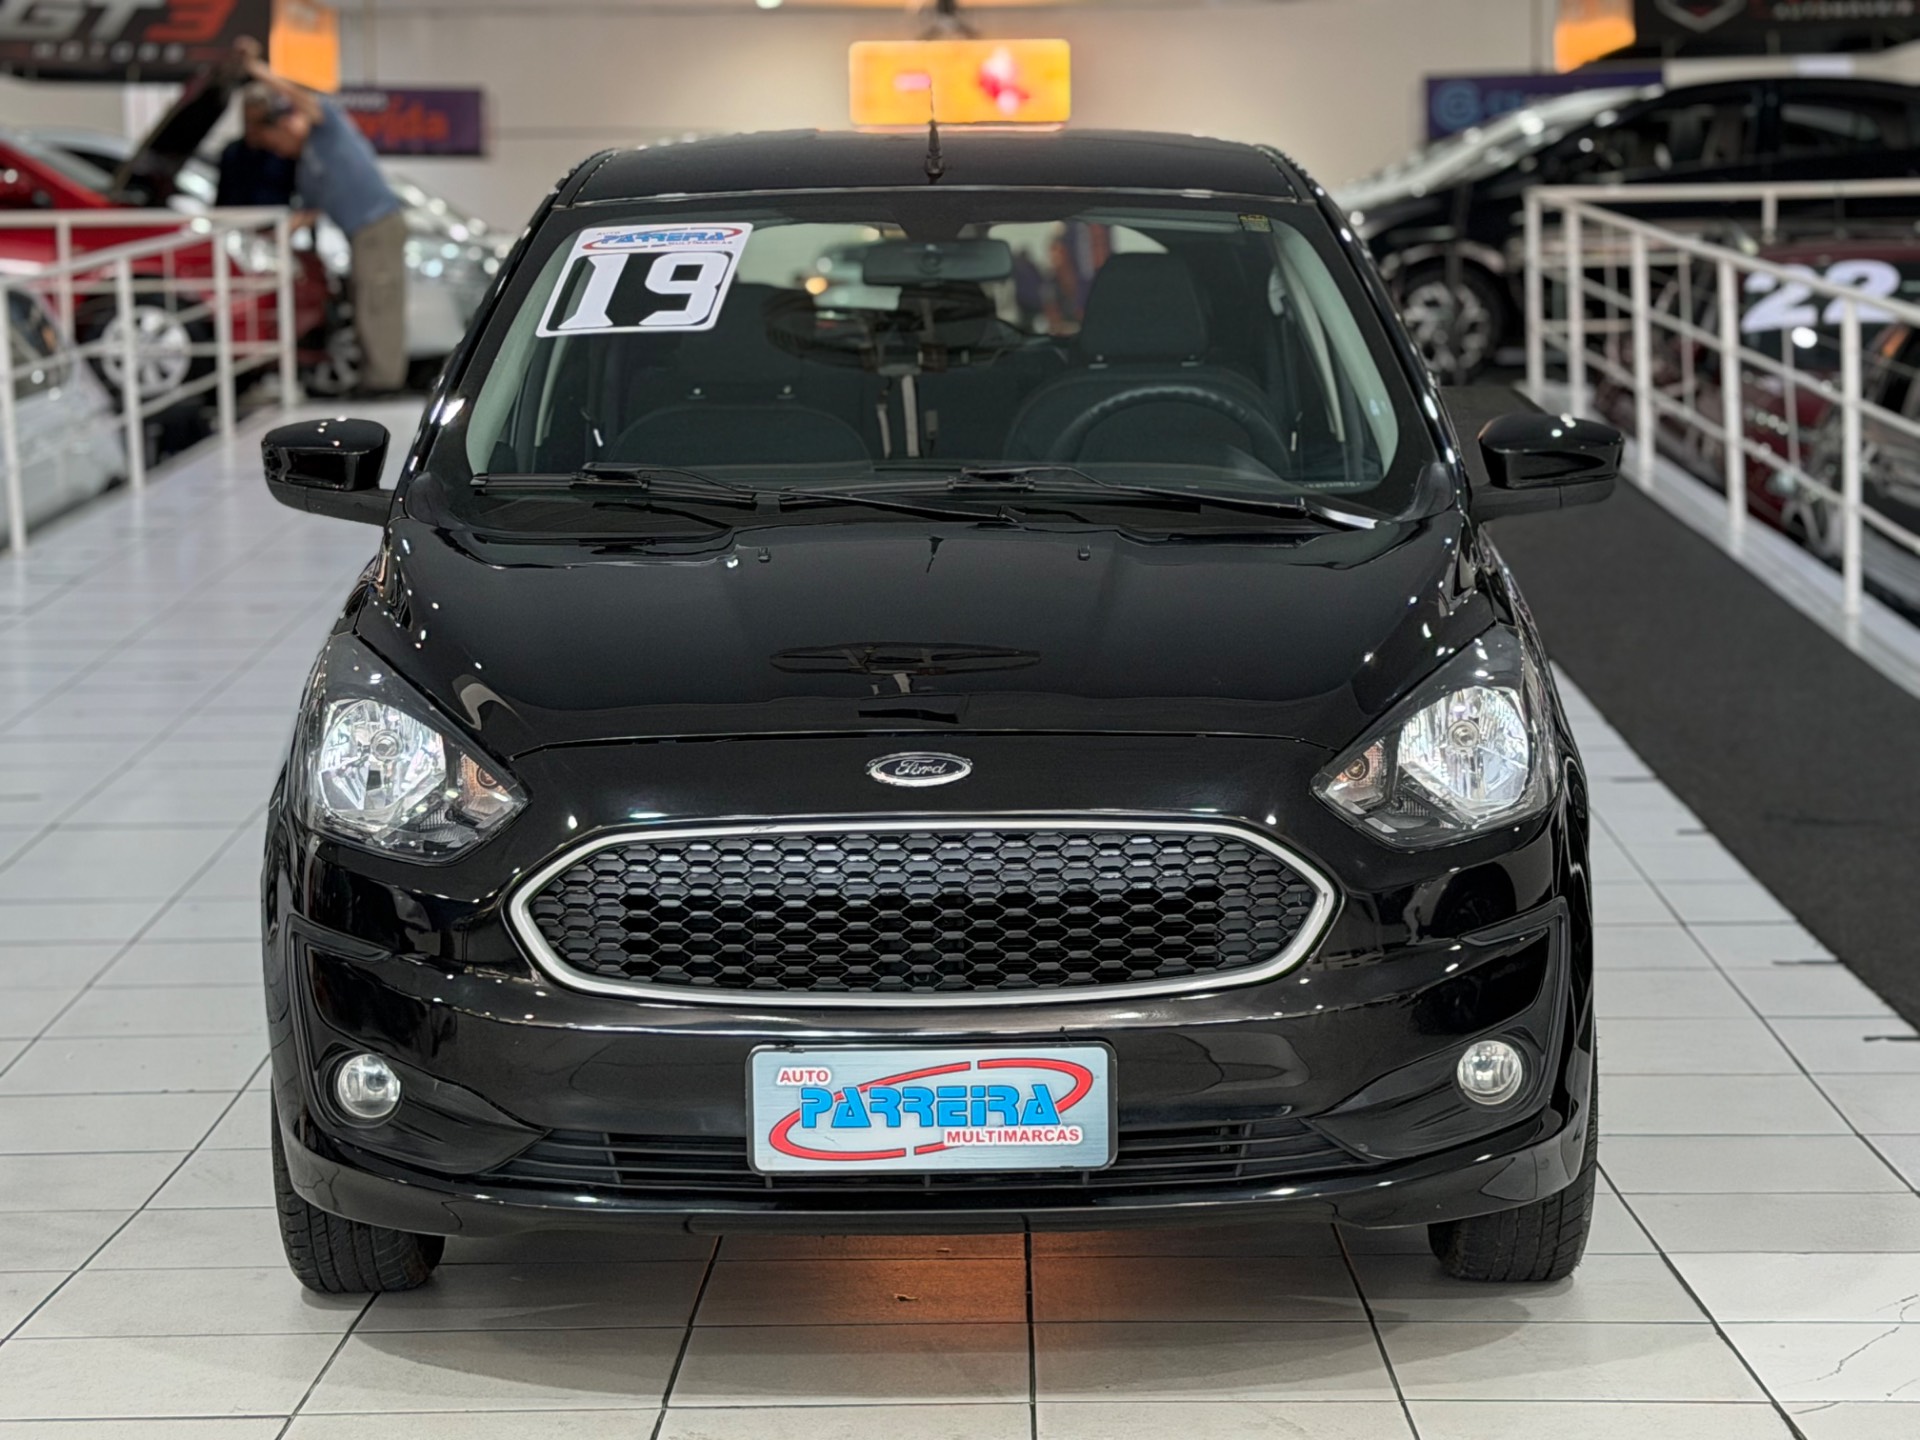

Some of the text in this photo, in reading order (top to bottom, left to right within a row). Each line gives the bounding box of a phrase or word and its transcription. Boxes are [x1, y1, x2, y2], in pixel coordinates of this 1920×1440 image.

[557, 251, 730, 330] 19
[1741, 258, 1901, 334] 22
[895, 759, 948, 776] Ford
[779, 1069, 830, 1084] AUTO
[801, 1084, 1061, 1129] PARREIRA
[946, 1128, 1080, 1144] MULTIMARCAS
